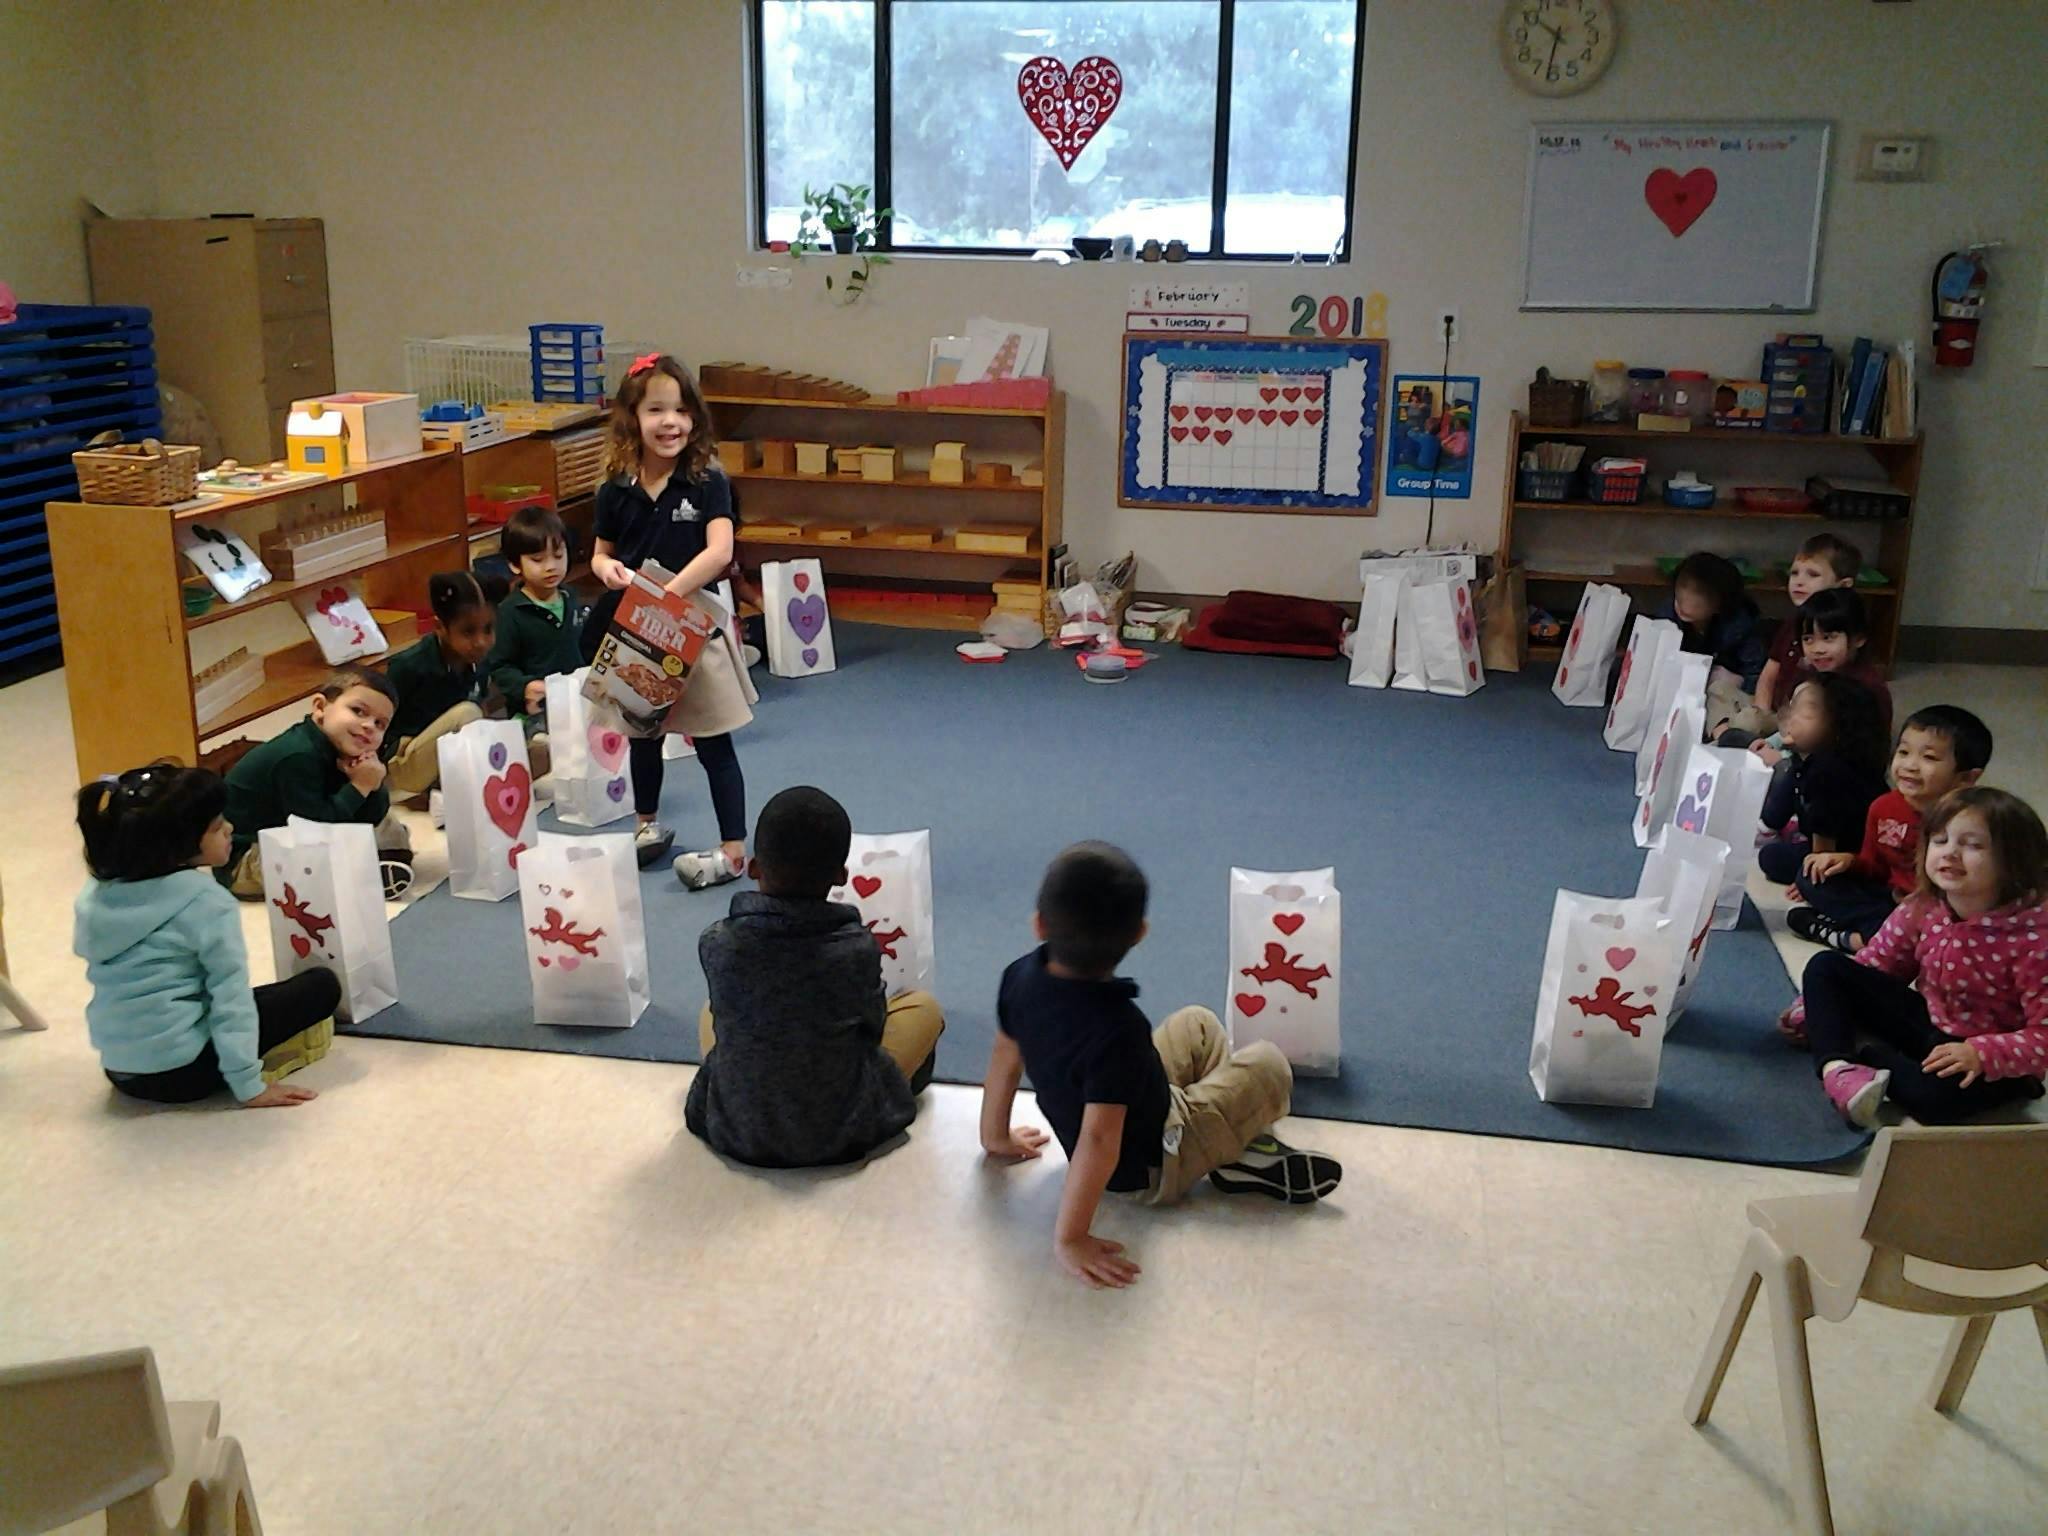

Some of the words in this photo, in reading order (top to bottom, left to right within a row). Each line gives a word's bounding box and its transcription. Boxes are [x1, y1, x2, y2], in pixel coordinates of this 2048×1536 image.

[1157, 291, 1220, 303] February
[1289, 290, 1389, 338] 2018
[1164, 317, 1212, 331] Tuesday
[1397, 477, 1431, 490] Group
[1434, 478, 1460, 490] Time
[629, 604, 687, 652] FIBER
